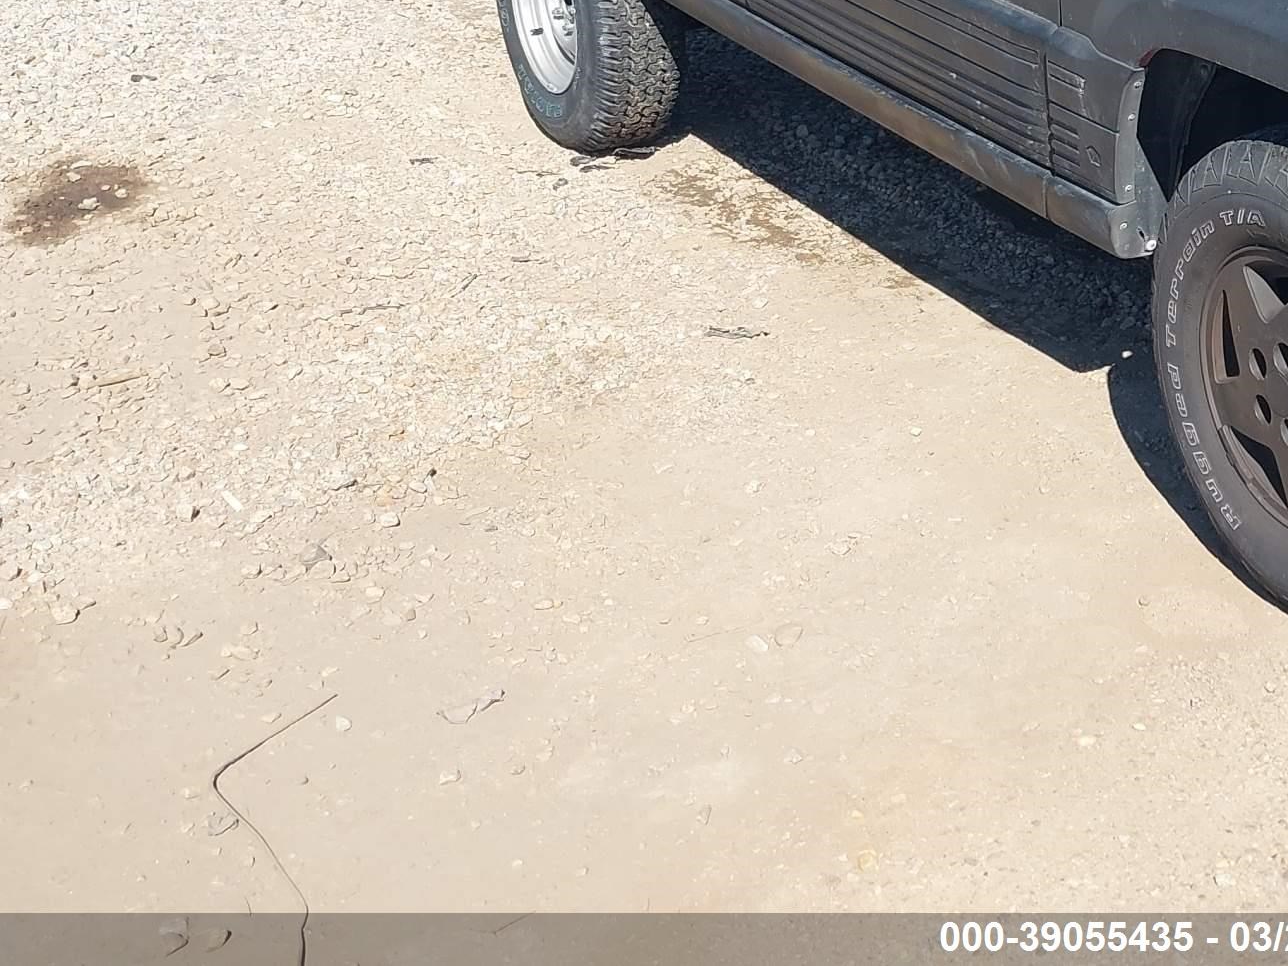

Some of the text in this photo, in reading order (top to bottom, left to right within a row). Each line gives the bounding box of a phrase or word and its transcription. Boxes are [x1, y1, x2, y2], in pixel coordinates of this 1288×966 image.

[1165, 208, 1267, 531] Rugged Terrain T/A
